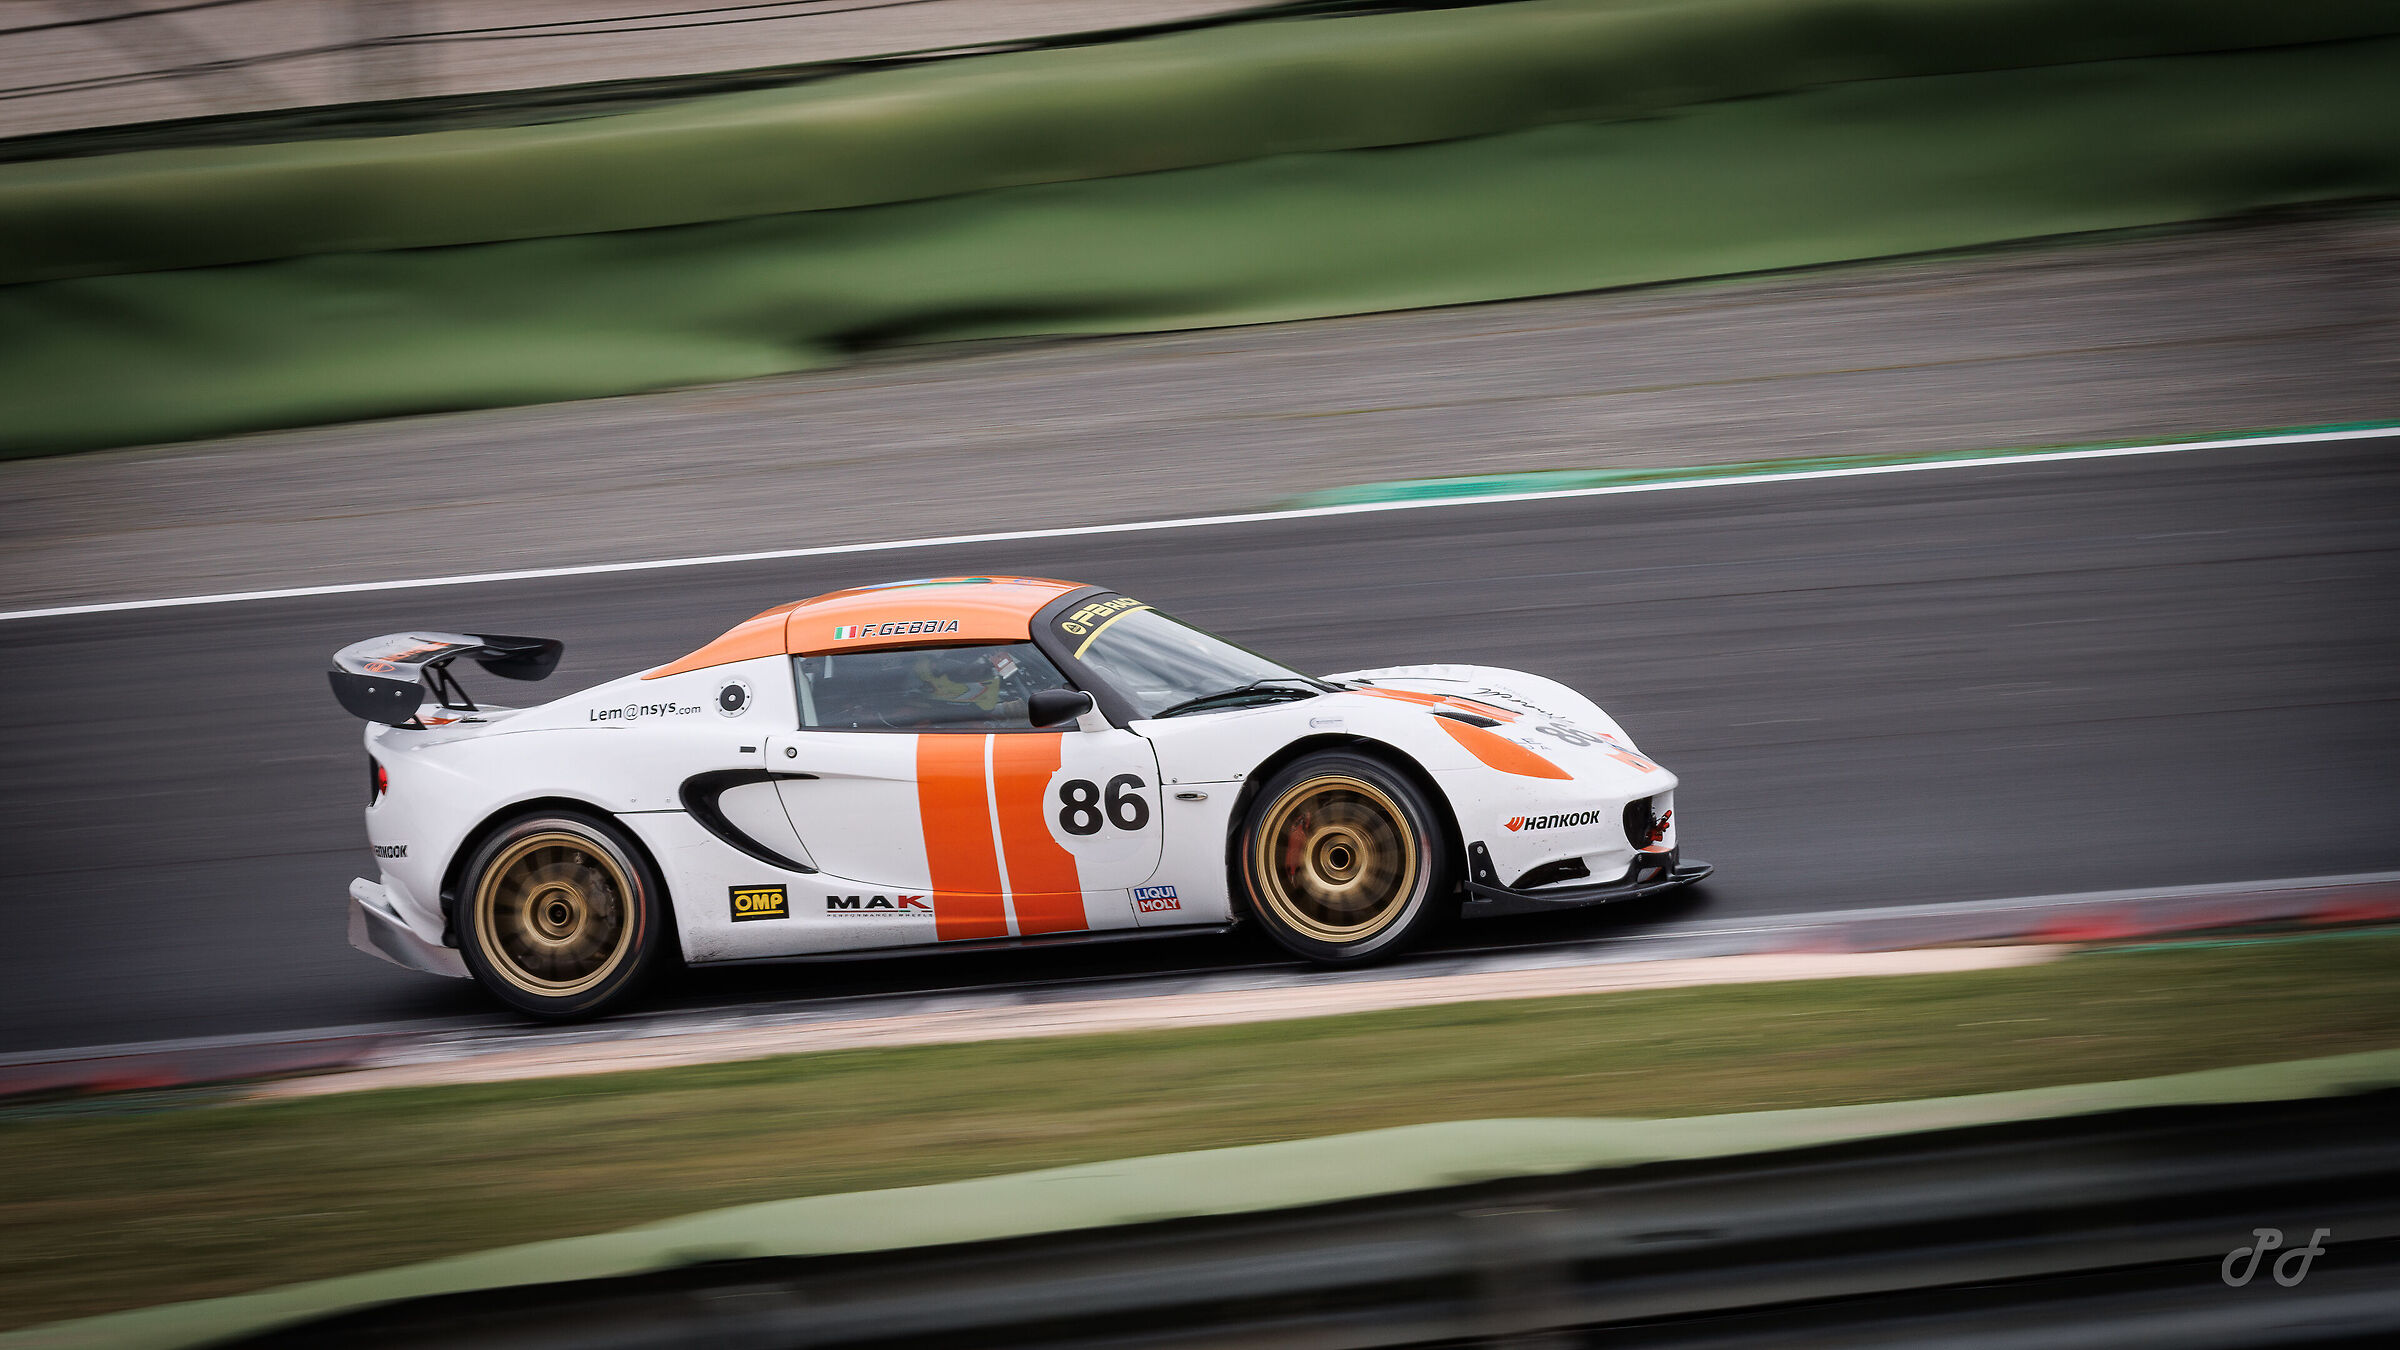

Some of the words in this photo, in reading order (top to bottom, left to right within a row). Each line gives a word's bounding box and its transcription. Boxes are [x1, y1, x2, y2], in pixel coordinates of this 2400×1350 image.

[860, 620, 959, 637] F.GEBBIA
[590, 702, 701, 721] Lem@nsys.com
[1058, 773, 1150, 836] 86
[735, 893, 784, 911] OMP
[826, 895, 932, 909] MAK
[1135, 887, 1176, 900] LIQUI
[1139, 898, 1178, 912] MOLY
